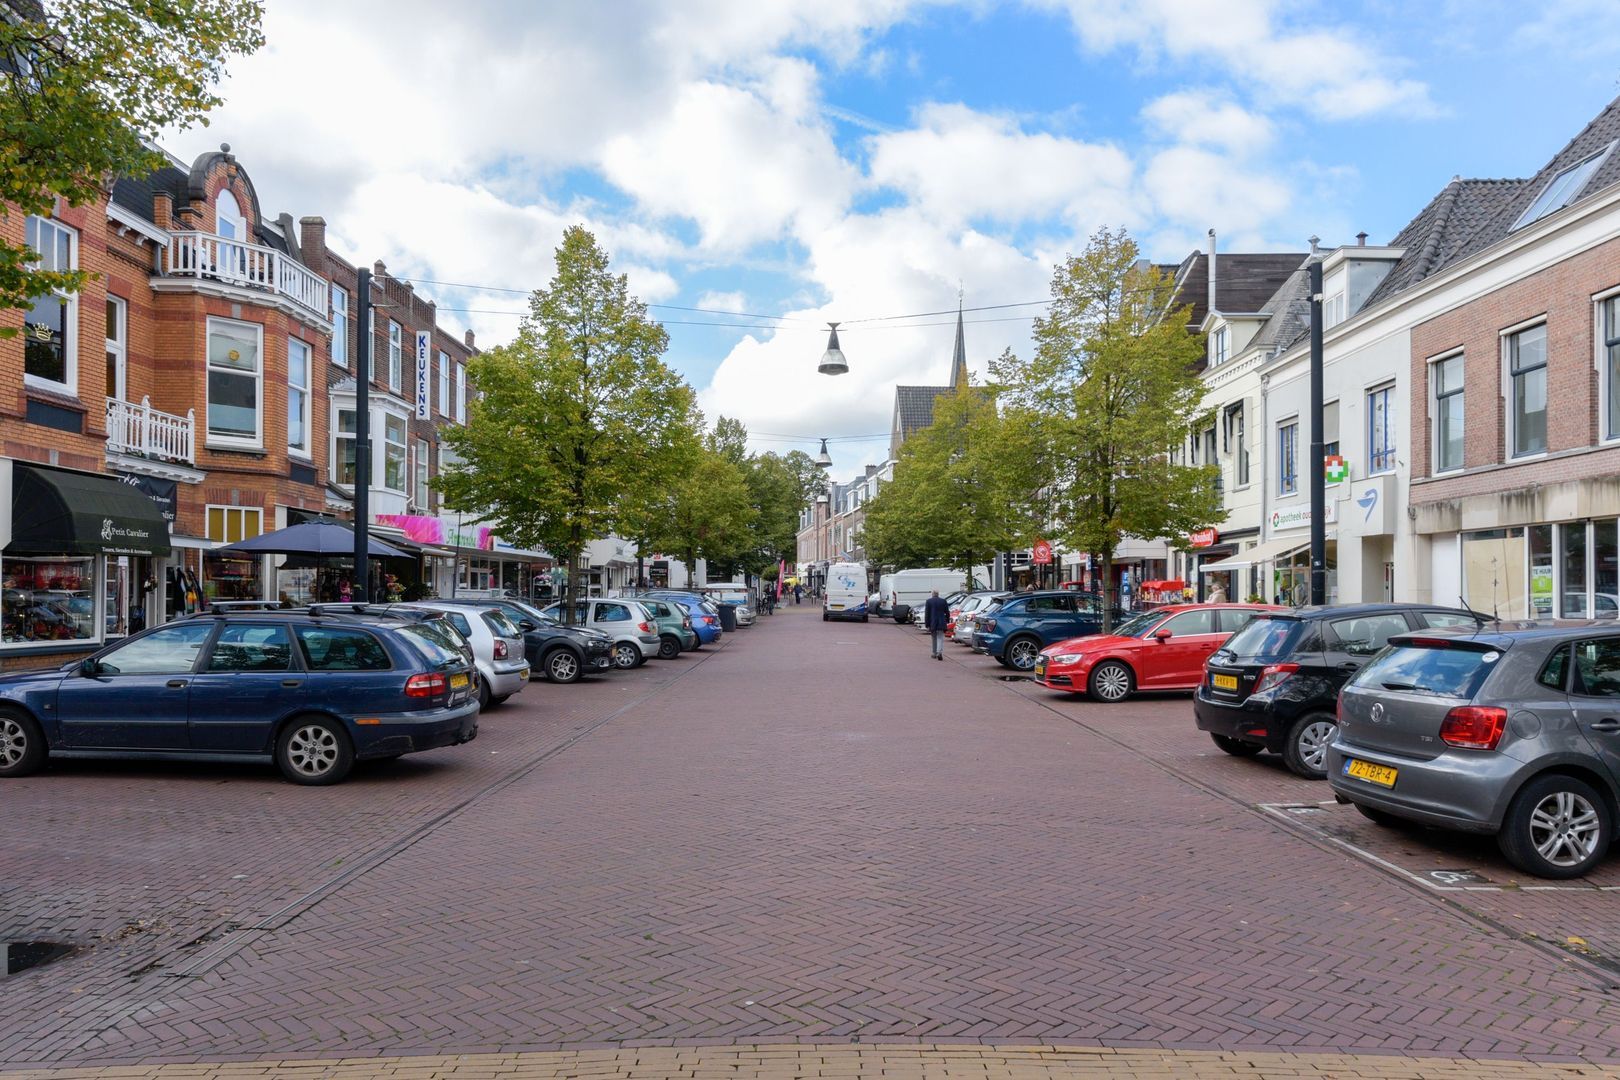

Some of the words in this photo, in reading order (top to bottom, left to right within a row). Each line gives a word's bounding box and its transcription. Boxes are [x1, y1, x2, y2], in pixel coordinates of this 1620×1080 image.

[418, 335, 426, 416] KEUKENS
[1280, 512, 1301, 523] apotheek
[111, 527, 126, 536] Petit
[126, 528, 149, 538] Cavalier
[1351, 760, 1392, 782] 72-TBR-4
